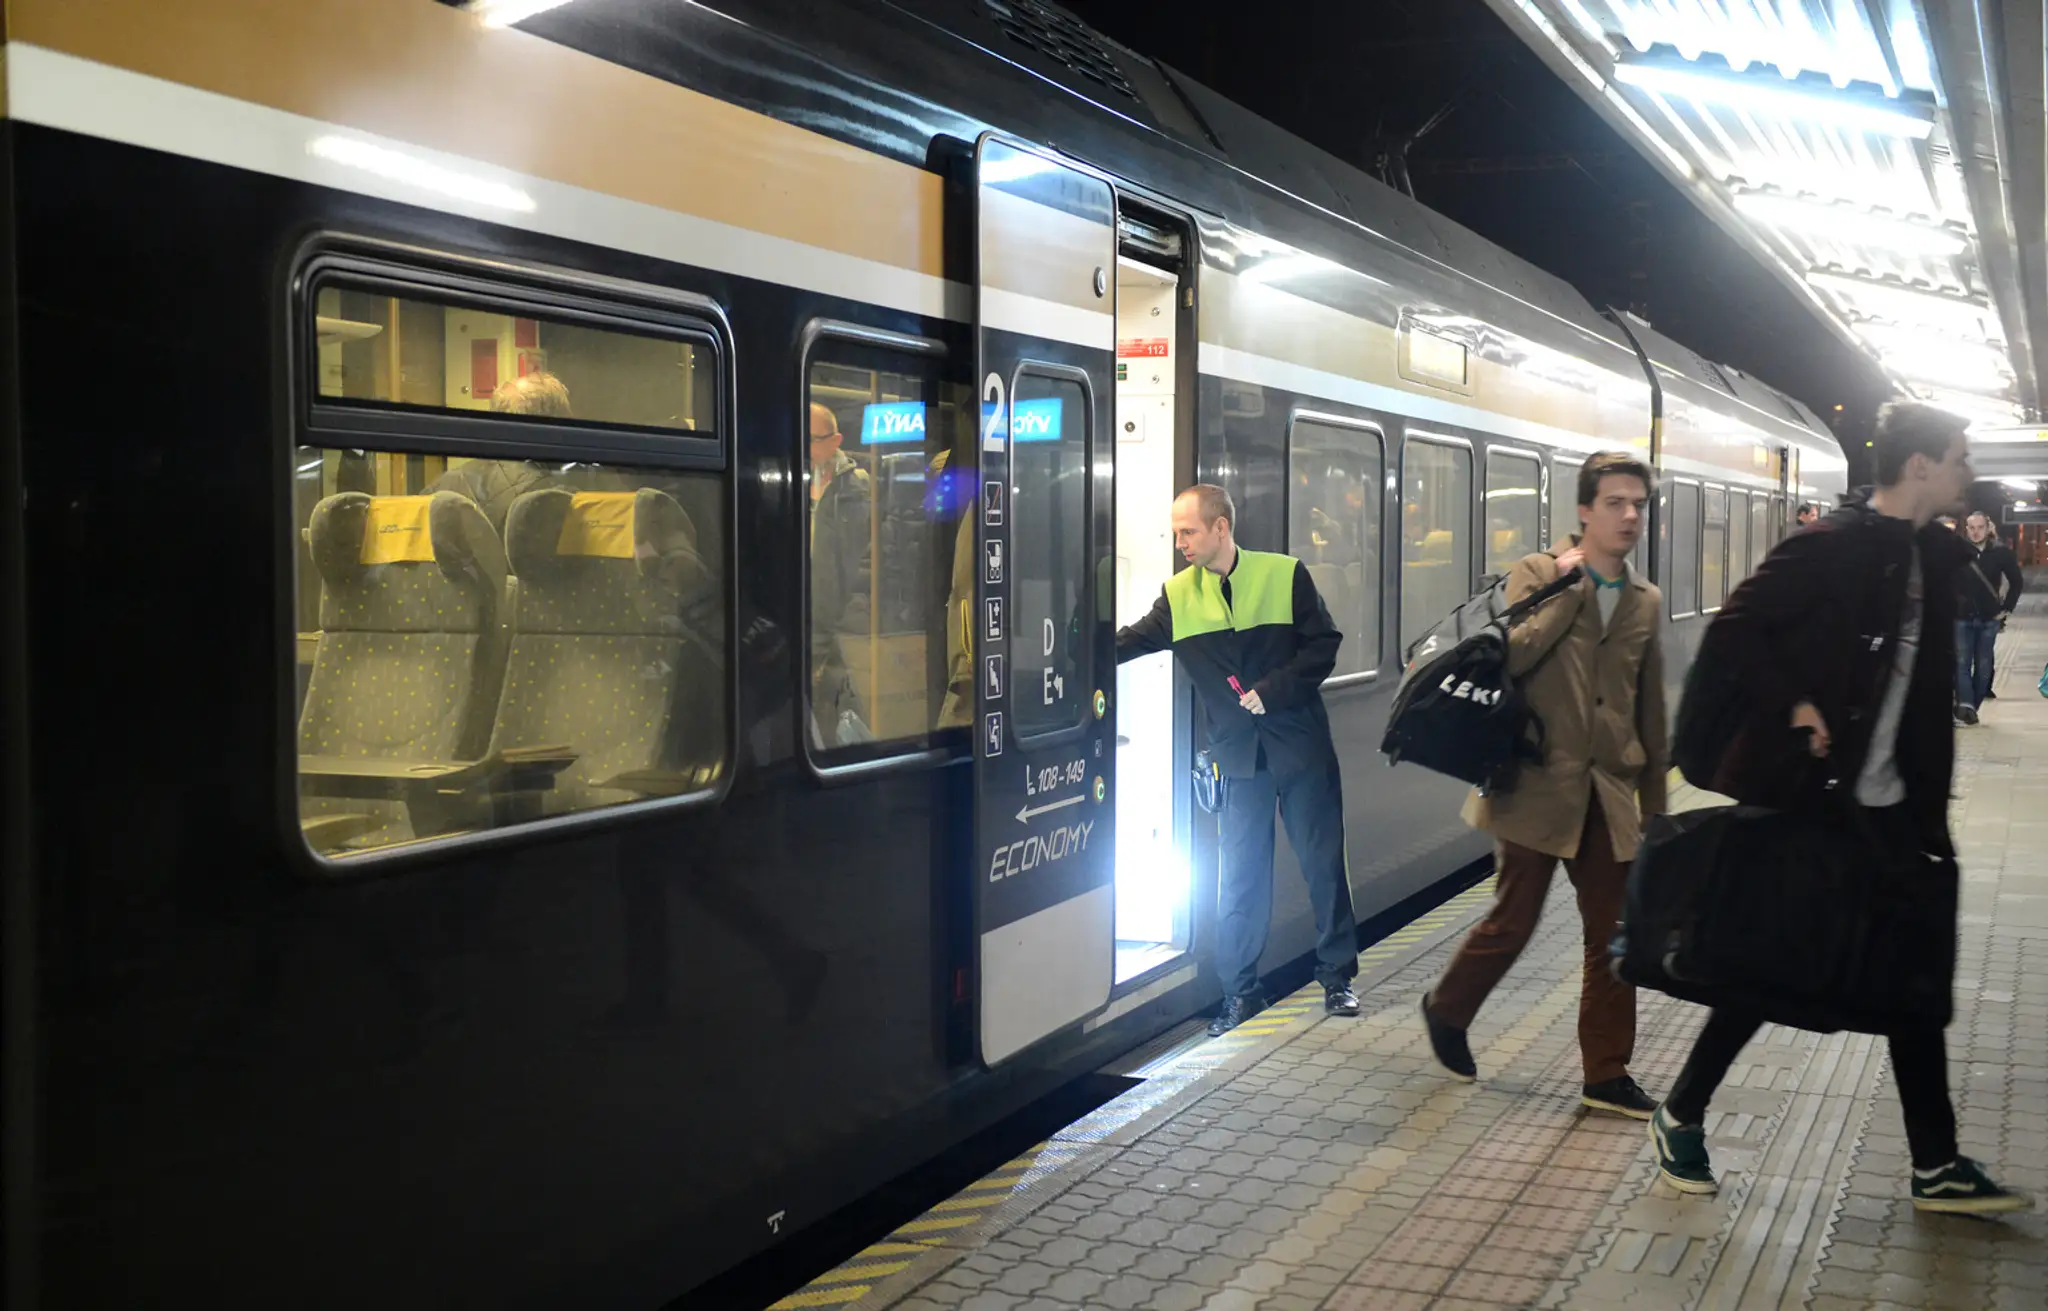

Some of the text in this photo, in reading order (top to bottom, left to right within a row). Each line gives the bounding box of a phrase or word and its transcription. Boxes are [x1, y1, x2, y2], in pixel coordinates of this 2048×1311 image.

[1147, 345, 1165, 355] 112
[983, 372, 1005, 452] 2
[1541, 465, 1548, 504] 2
[1043, 618, 1055, 656] D
[1043, 667, 1054, 705] E
[1037, 759, 1086, 792] 108-149
[989, 819, 1094, 883] ECONOMY
